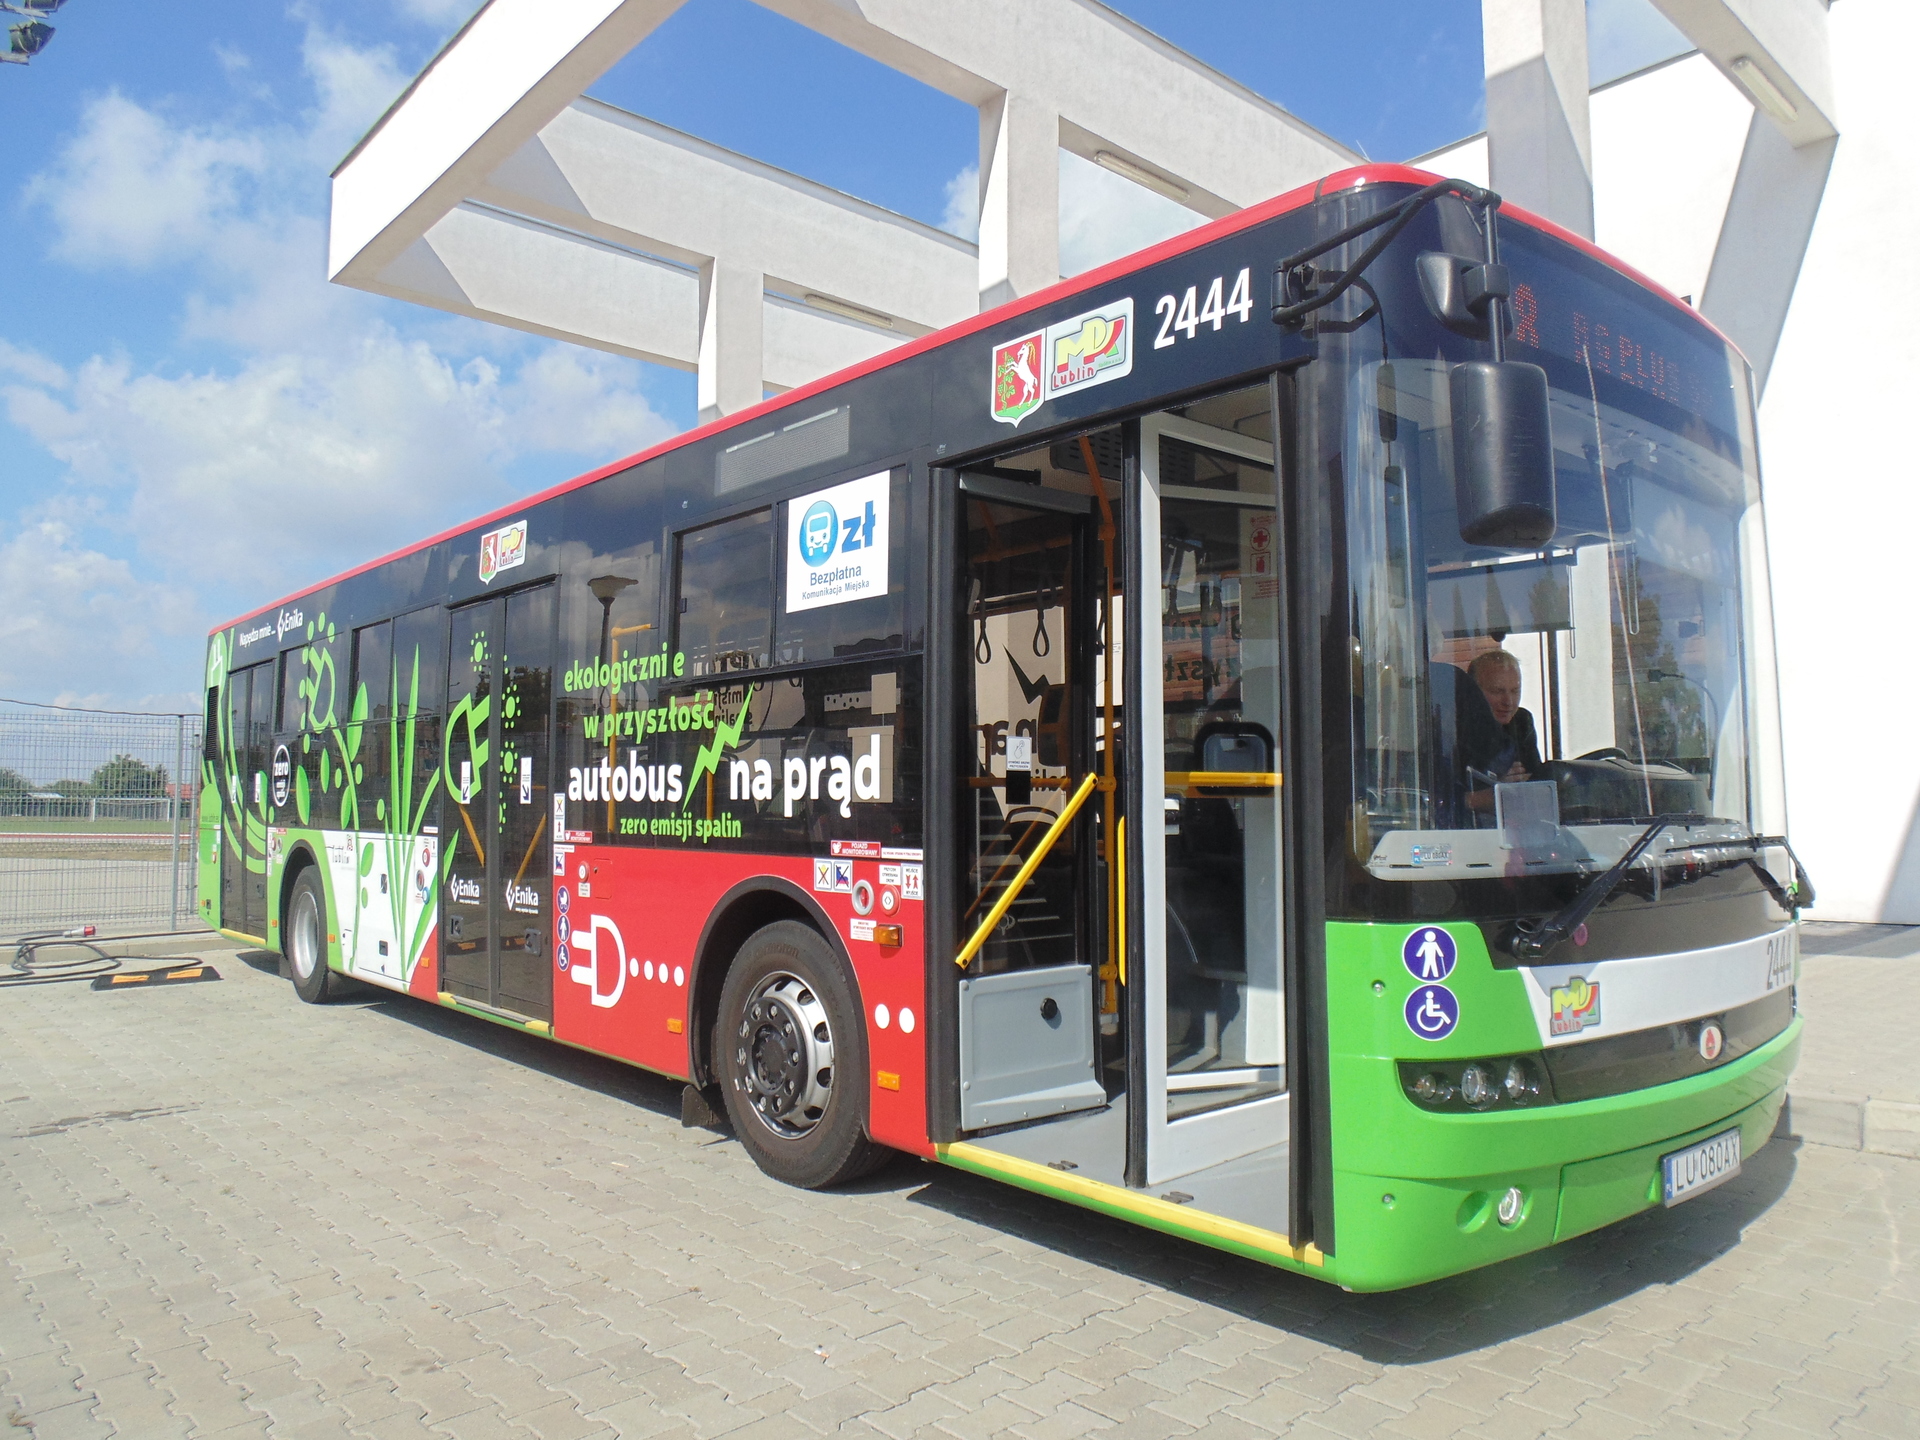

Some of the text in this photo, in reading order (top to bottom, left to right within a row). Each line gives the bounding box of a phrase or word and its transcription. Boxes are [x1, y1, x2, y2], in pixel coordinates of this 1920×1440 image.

[1154, 267, 1254, 350] 2444
[1053, 366, 1095, 388] Lublin
[810, 565, 862, 586] Bezpłatna
[802, 579, 870, 600] Komunikacja Miejska
[285, 608, 304, 632] Enika
[583, 691, 715, 747] w przyszłość
[274, 761, 289, 777] zero
[568, 733, 881, 819] autobus na prąd
[620, 811, 742, 843] zero emisji spalin
[842, 848, 878, 856] MONITOROWANY
[459, 879, 480, 898] Enika
[515, 885, 539, 906] Enika
[1551, 1018, 1583, 1034] Lublin
[1675, 1152, 1696, 1192] LU
[1699, 1133, 1740, 1180] 080AX
